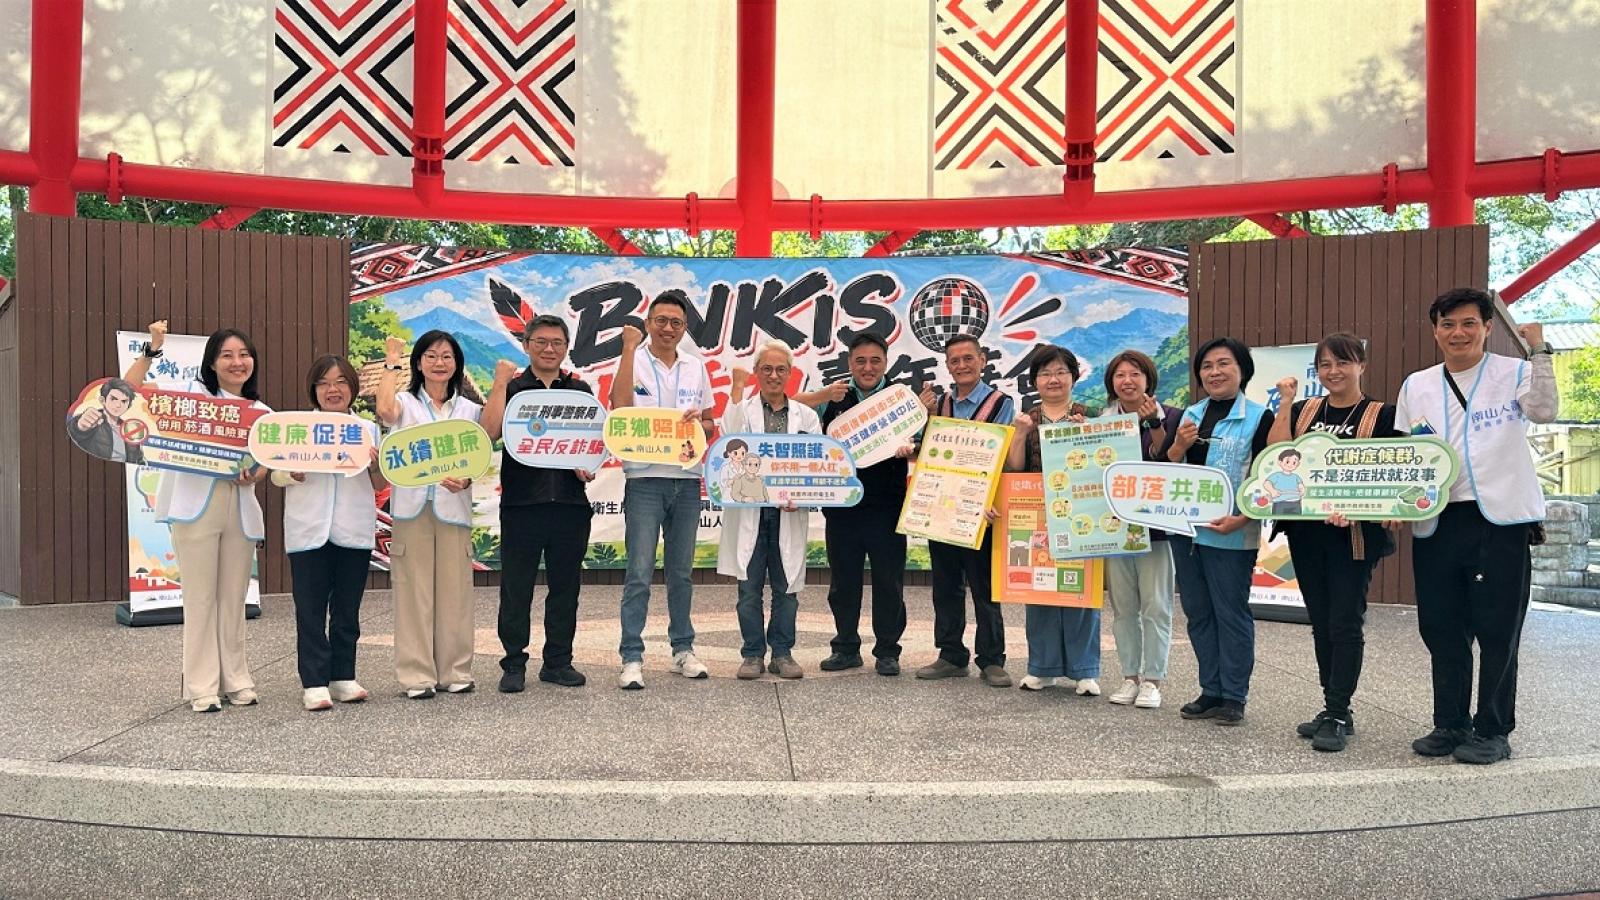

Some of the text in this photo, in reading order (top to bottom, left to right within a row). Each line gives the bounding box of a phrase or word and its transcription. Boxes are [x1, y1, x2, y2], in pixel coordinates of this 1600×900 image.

[149, 392, 241, 424] 檳榔致癌
[539, 405, 598, 419] 刑事警察局
[257, 422, 363, 445] 健康促進
[609, 417, 695, 439] 原鄉照顧
[386, 430, 480, 470] 永續健康
[516, 438, 605, 454] 全民反詐騙
[770, 462, 836, 473] 你不用一個人扛
[1112, 475, 1224, 503] 部落共融
[1155, 506, 1200, 516] 南山人壽
